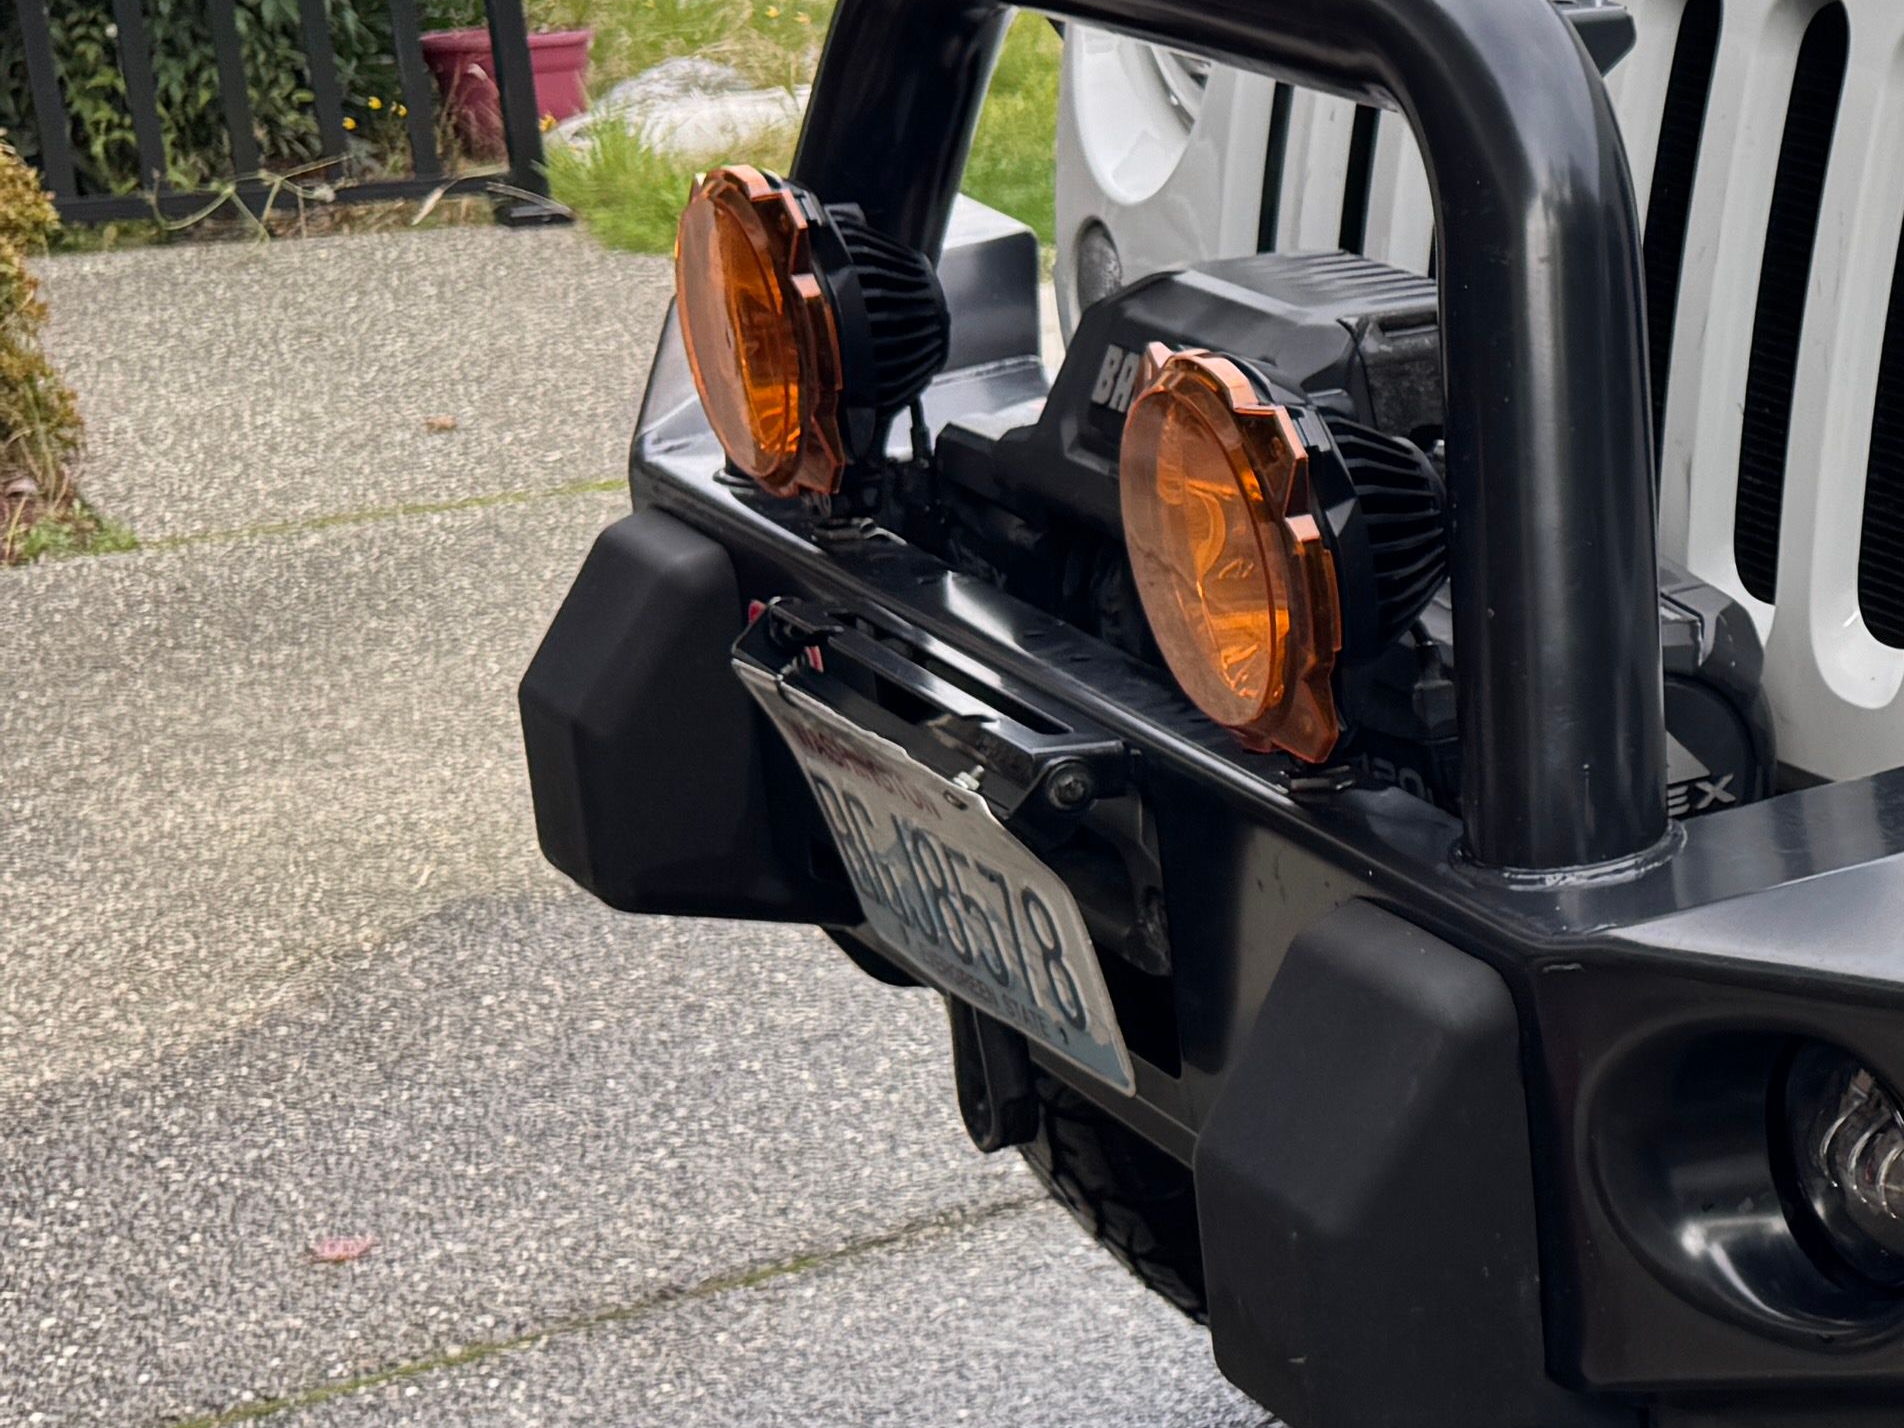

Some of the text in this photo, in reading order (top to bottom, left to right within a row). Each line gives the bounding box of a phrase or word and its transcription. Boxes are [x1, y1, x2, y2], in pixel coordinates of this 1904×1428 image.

[1091, 344, 1142, 414] BA
[1666, 773, 1737, 817] EX
[811, 773, 1087, 1032] BGJ8578
